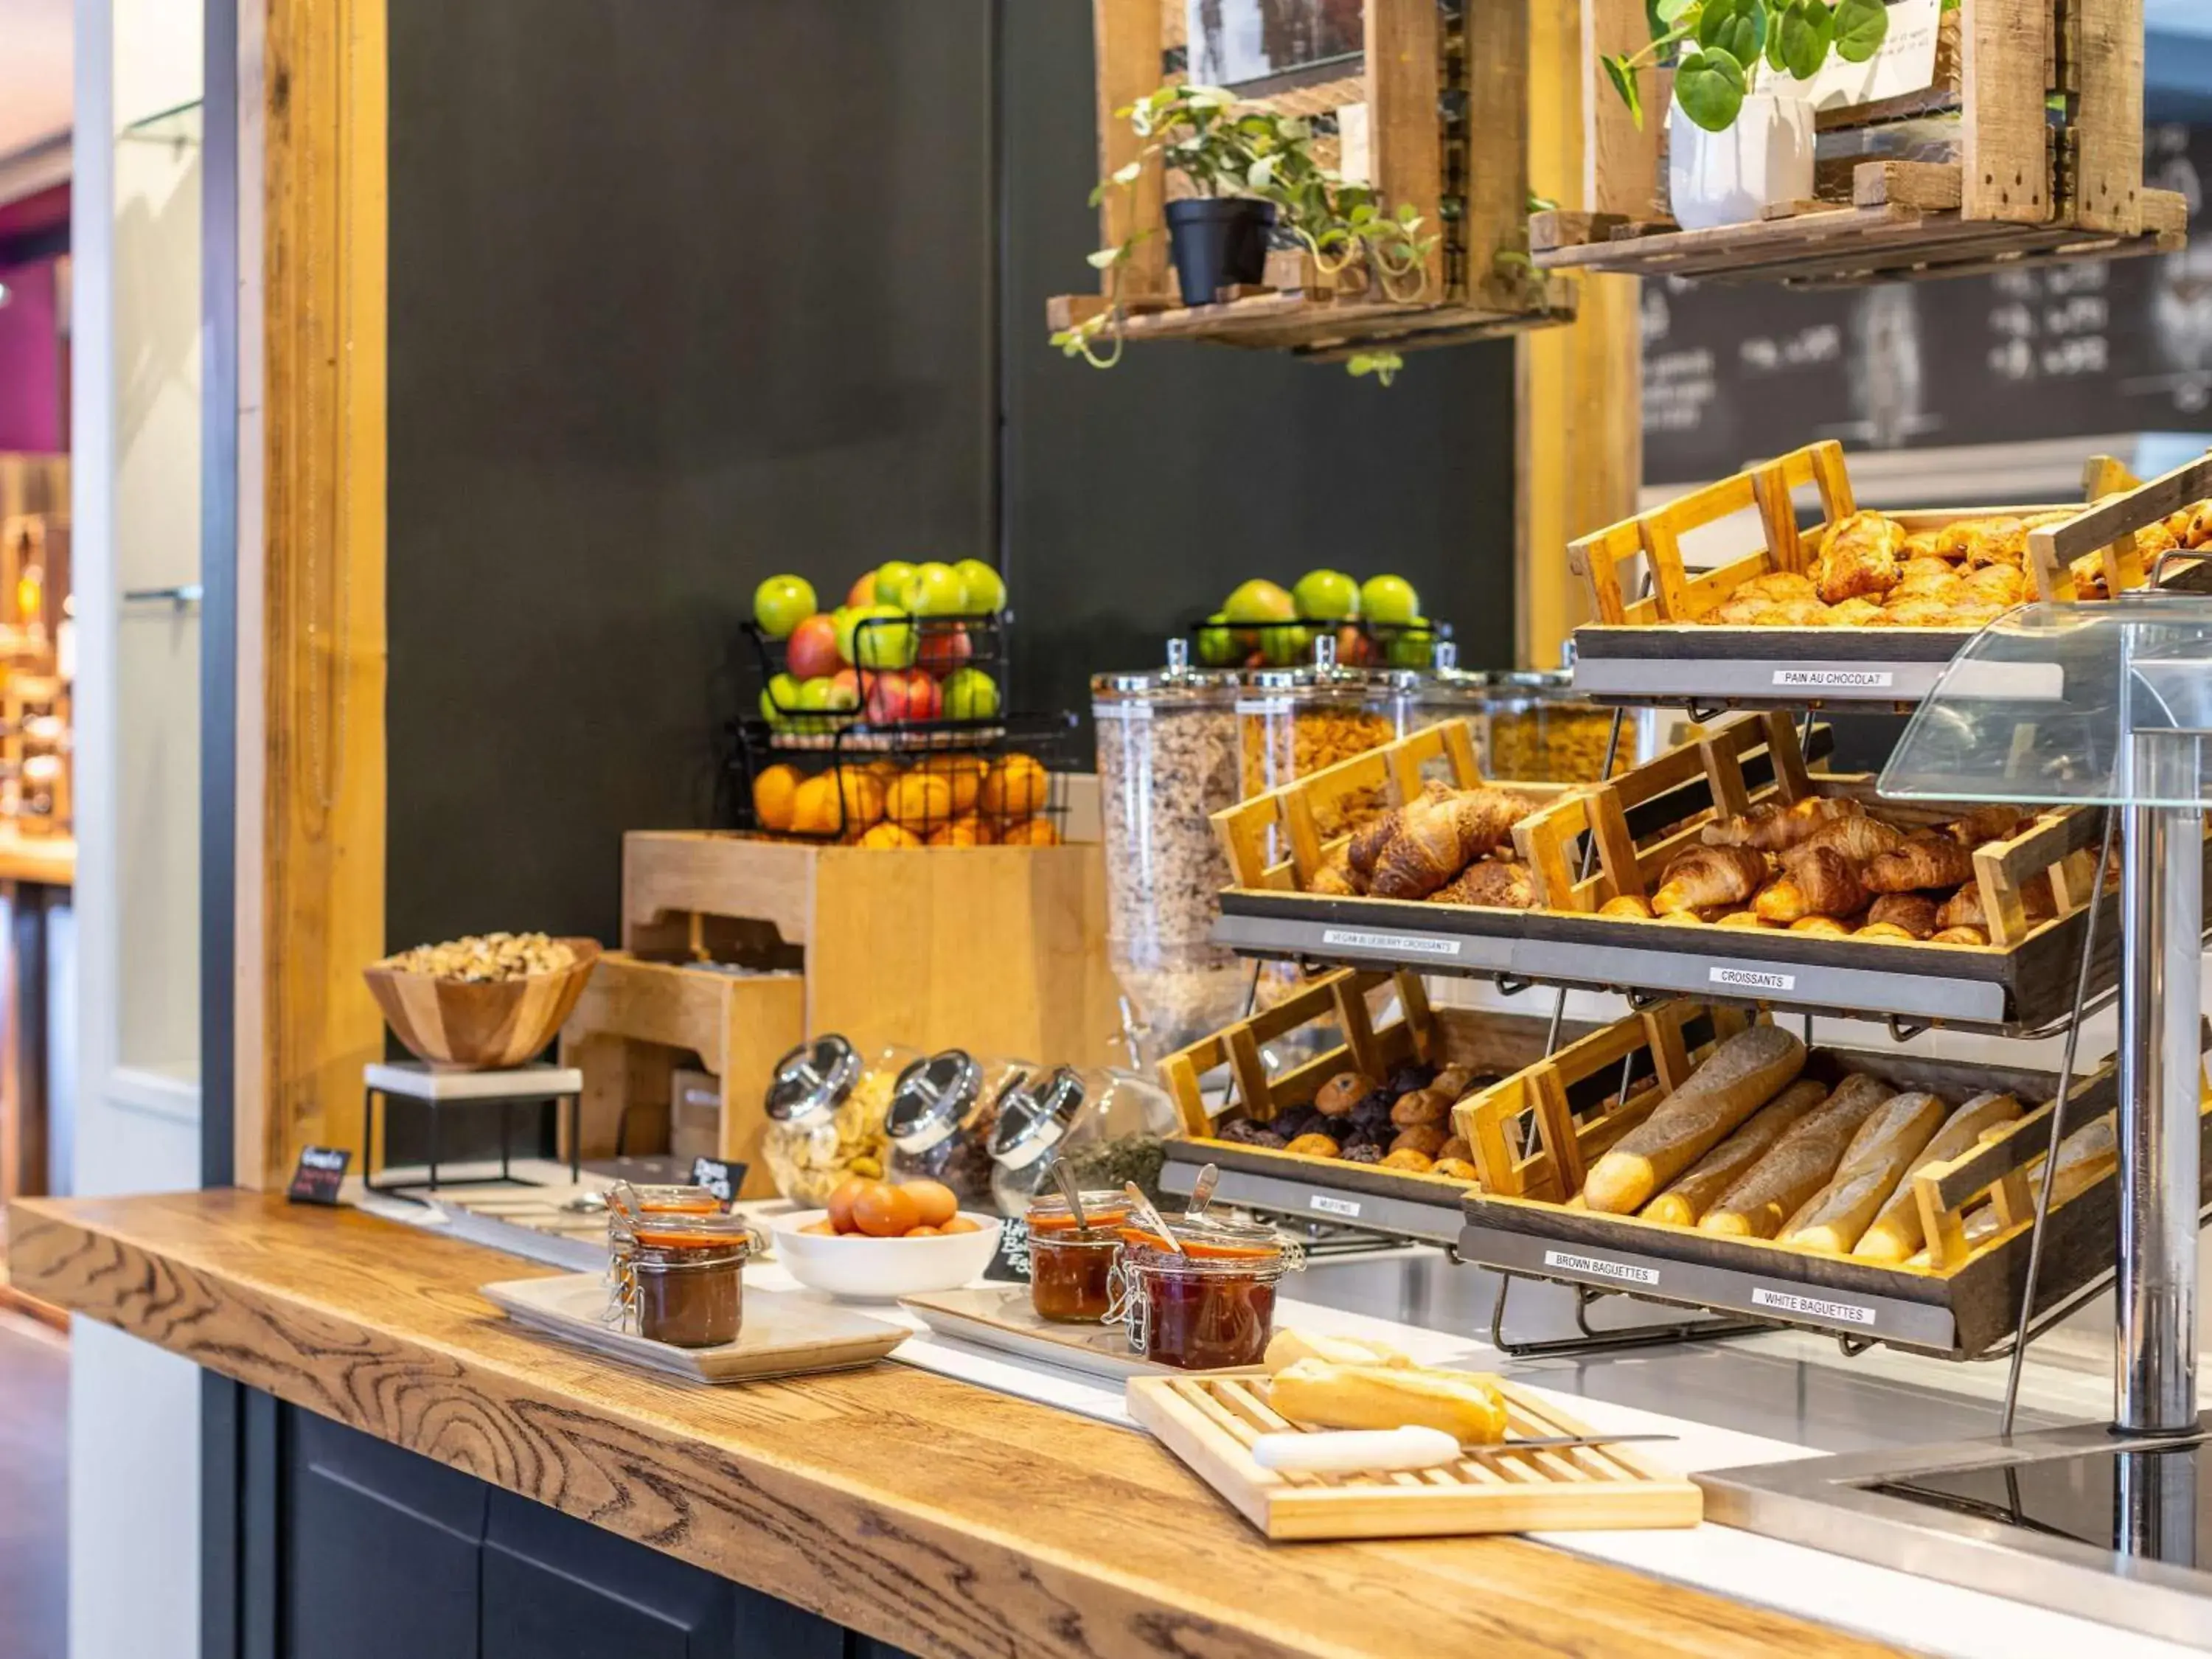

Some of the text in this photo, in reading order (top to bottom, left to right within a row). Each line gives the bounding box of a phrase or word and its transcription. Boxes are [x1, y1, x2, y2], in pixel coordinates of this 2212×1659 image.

[1785, 672, 1881, 685] PAIN AU CHOCOLAT
[1721, 970, 1784, 987] CROISSANTS
[1557, 1254, 1649, 1281] BROWN BAGUETTES
[1764, 1292, 1864, 1321] WHITE BAGUETTES
